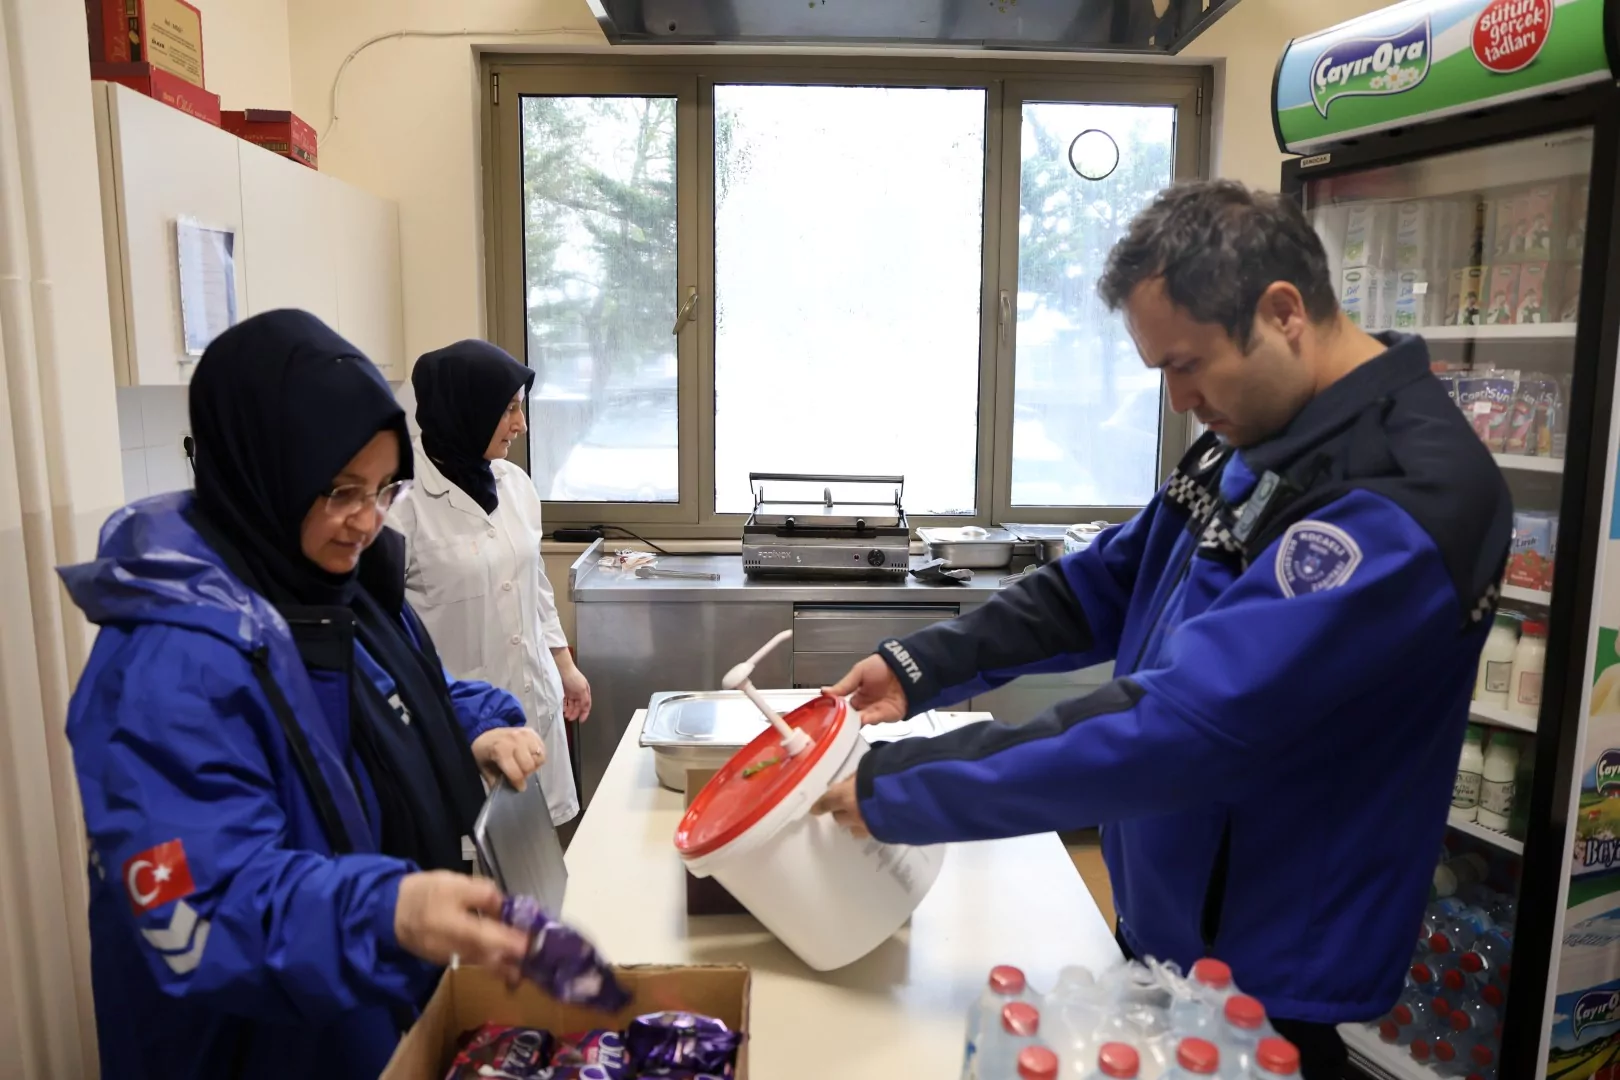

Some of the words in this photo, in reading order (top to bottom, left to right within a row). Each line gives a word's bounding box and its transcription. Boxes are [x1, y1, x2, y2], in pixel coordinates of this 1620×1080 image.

[1484, 31, 1536, 63] tadları
[1490, 6, 1544, 46] gerçek
[1315, 40, 1425, 94] ÇayırOva
[884, 640, 923, 684] ZABITA
